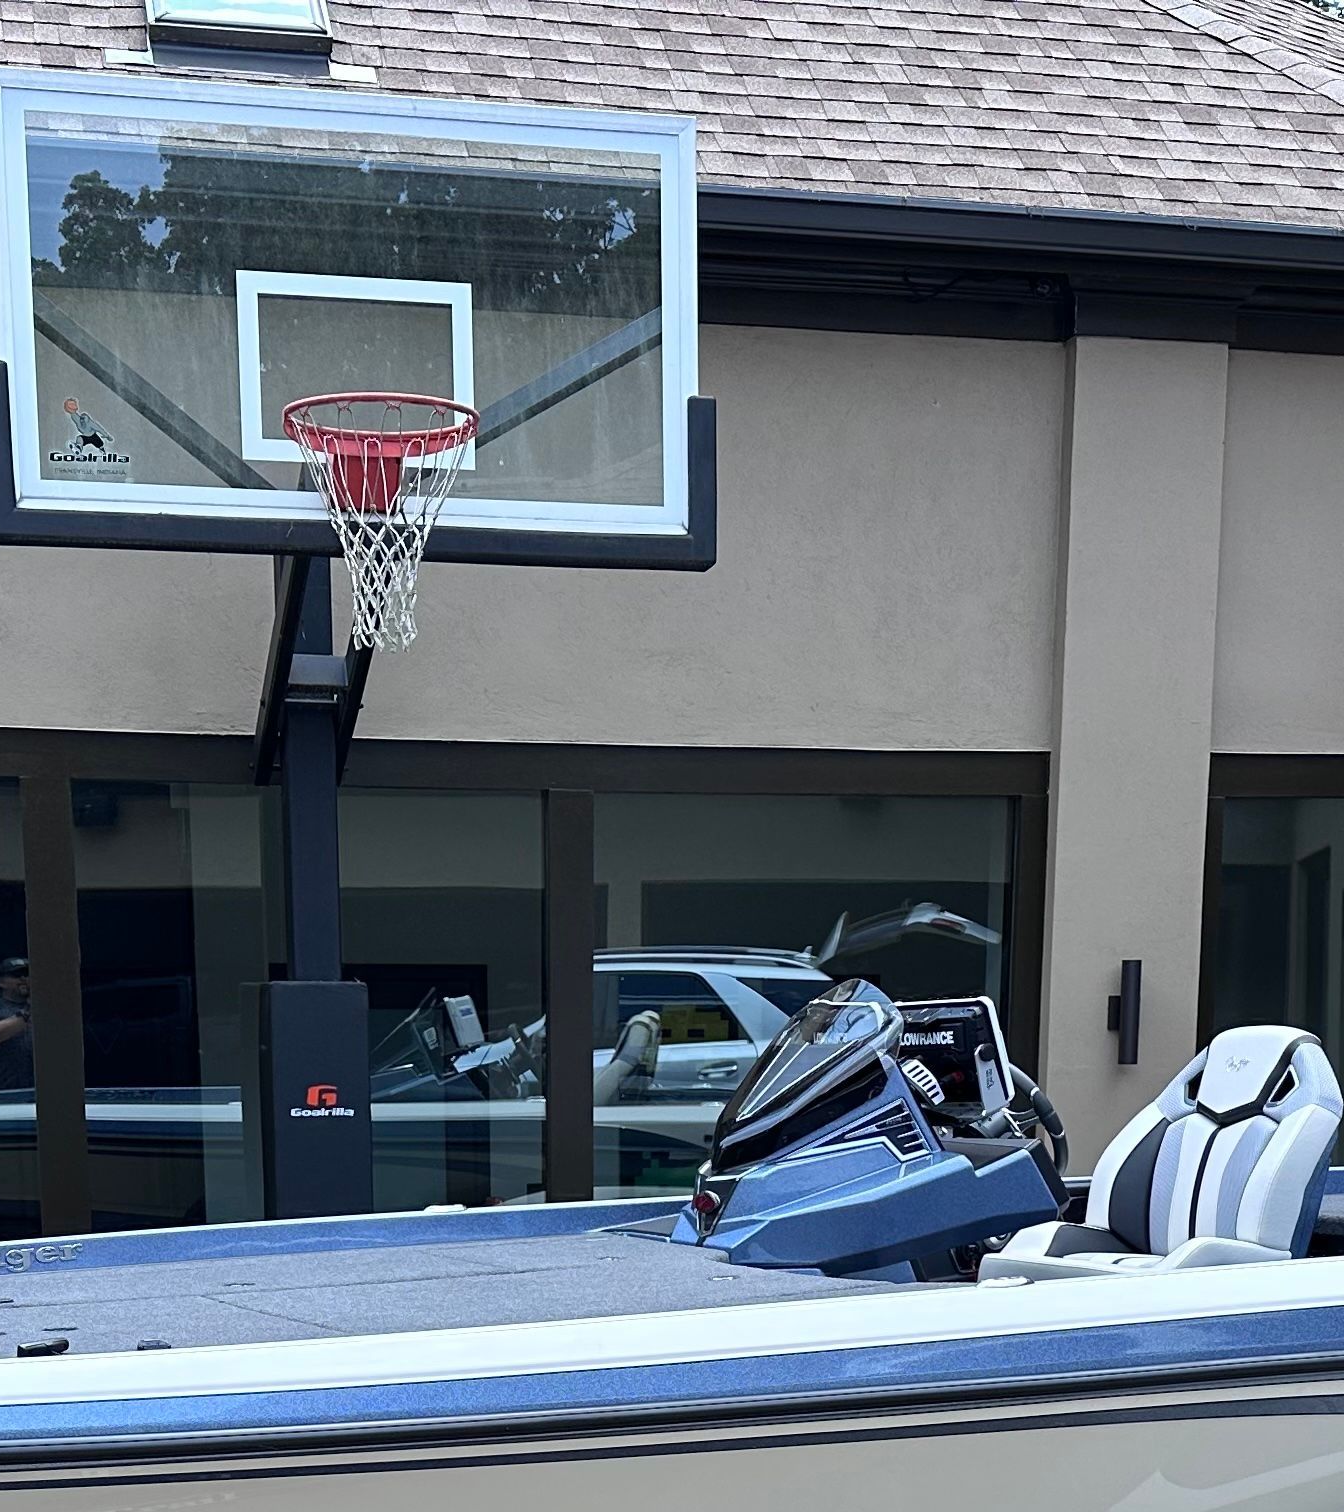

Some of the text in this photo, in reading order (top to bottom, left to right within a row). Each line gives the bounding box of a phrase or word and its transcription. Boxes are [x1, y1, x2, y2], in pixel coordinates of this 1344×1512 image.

[49, 452, 130, 463] Goalrilla
[899, 1030, 955, 1046] LOWRANCE
[290, 1107, 355, 1117] Goalrilla
